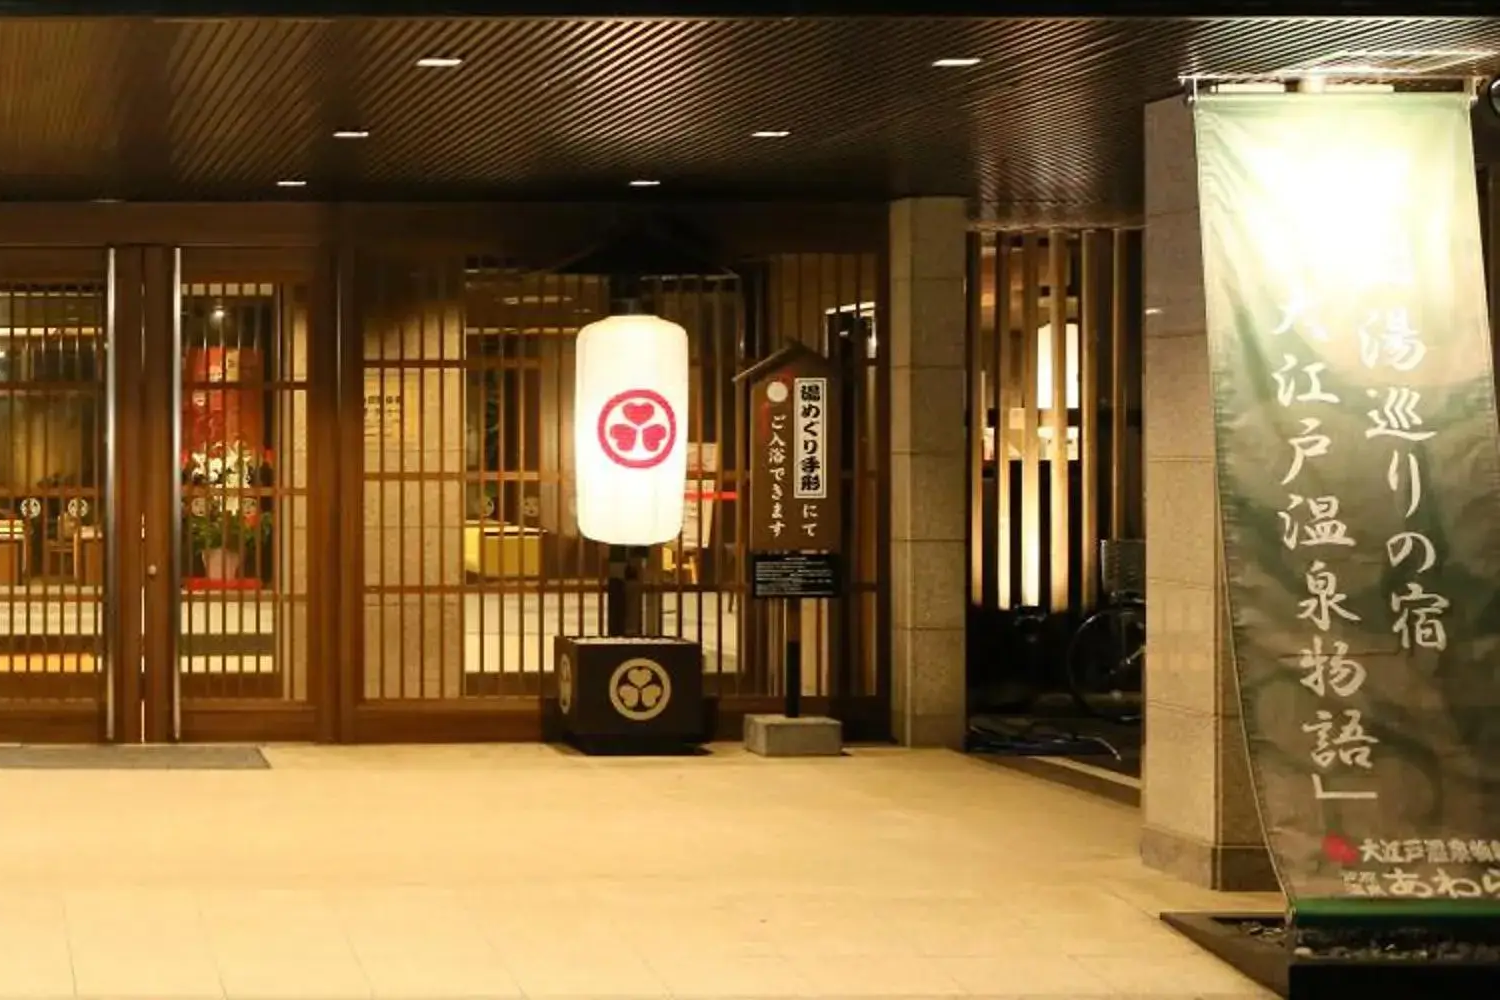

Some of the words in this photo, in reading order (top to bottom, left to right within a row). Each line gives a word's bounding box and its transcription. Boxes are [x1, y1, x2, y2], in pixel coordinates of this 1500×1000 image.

[768, 413, 787, 538] ご入浴できます
[800, 383, 821, 492] 湯めぐり手形
[1358, 306, 1450, 652] 湯巡りの宿
[802, 503, 818, 538] にて
